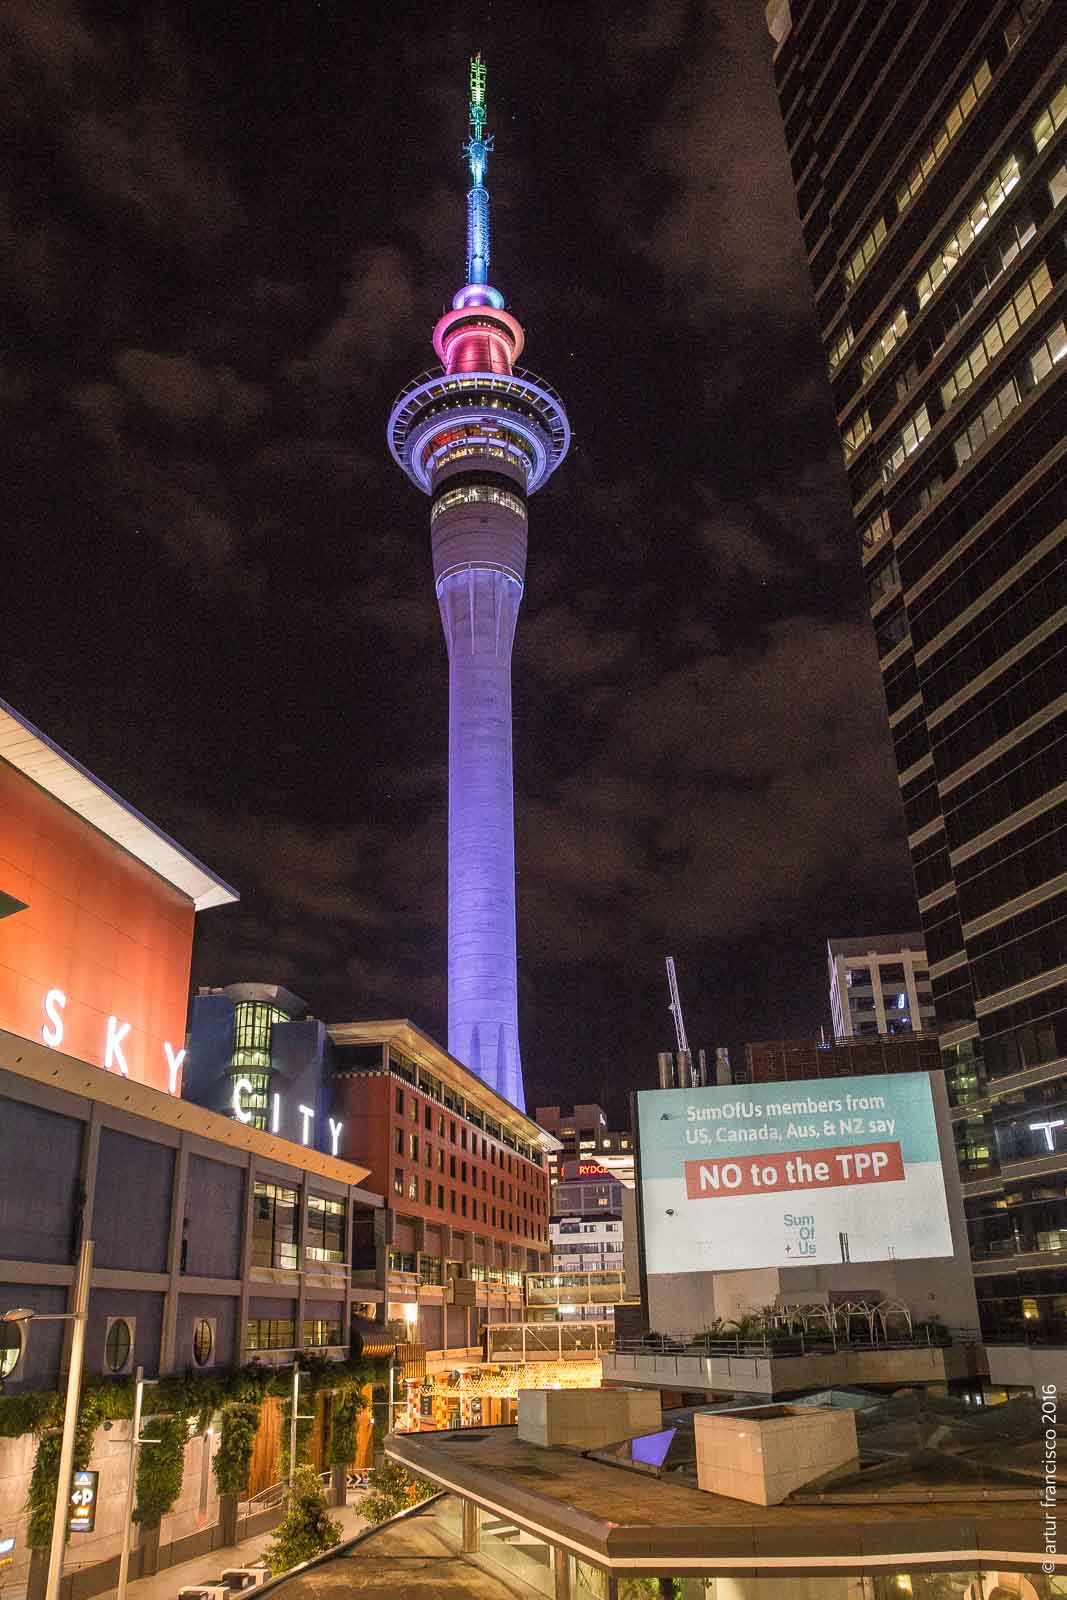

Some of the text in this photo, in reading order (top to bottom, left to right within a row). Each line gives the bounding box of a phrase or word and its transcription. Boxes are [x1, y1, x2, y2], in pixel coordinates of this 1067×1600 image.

[687, 1094, 886, 1121] SumOfUs members from
[686, 1118, 897, 1146] US, Canada, Aus, & NZ say
[699, 1151, 889, 1191] NO to the TPP
[783, 1214, 815, 1226] Sum
[799, 1226, 815, 1241] Of
[799, 1240, 817, 1255] Us
